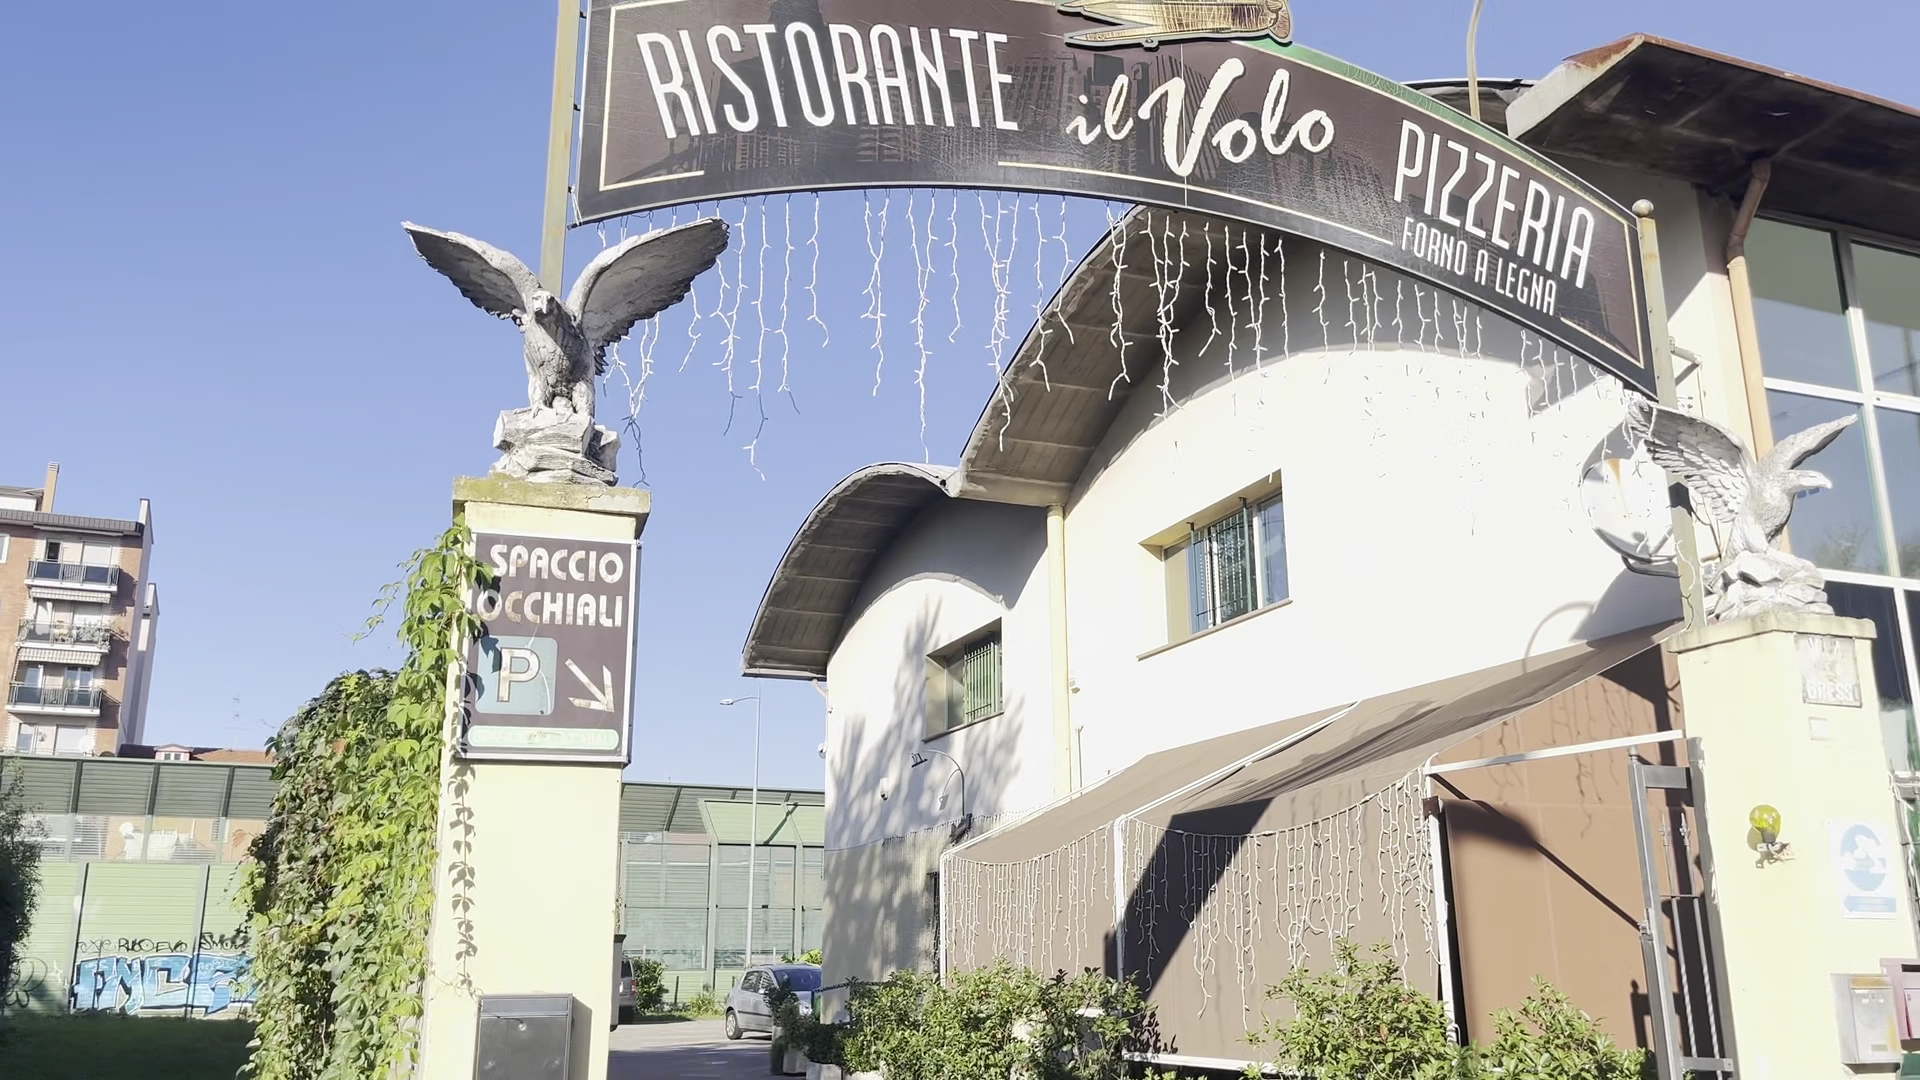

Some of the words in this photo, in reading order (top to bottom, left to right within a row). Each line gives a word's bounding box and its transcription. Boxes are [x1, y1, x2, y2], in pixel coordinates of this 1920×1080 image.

[636, 21, 1020, 140] RISTORANTE
[1066, 73, 1134, 146] il
[1138, 57, 1335, 177] Volo
[1393, 119, 1595, 289] PIZZERIA
[1401, 216, 1468, 276] FORNO
[1474, 249, 1489, 286] A
[1494, 257, 1557, 316] LEGNA
[476, 588, 623, 628] OCCHIALI
[489, 544, 624, 584] SPACCIO
[497, 647, 541, 703] P
